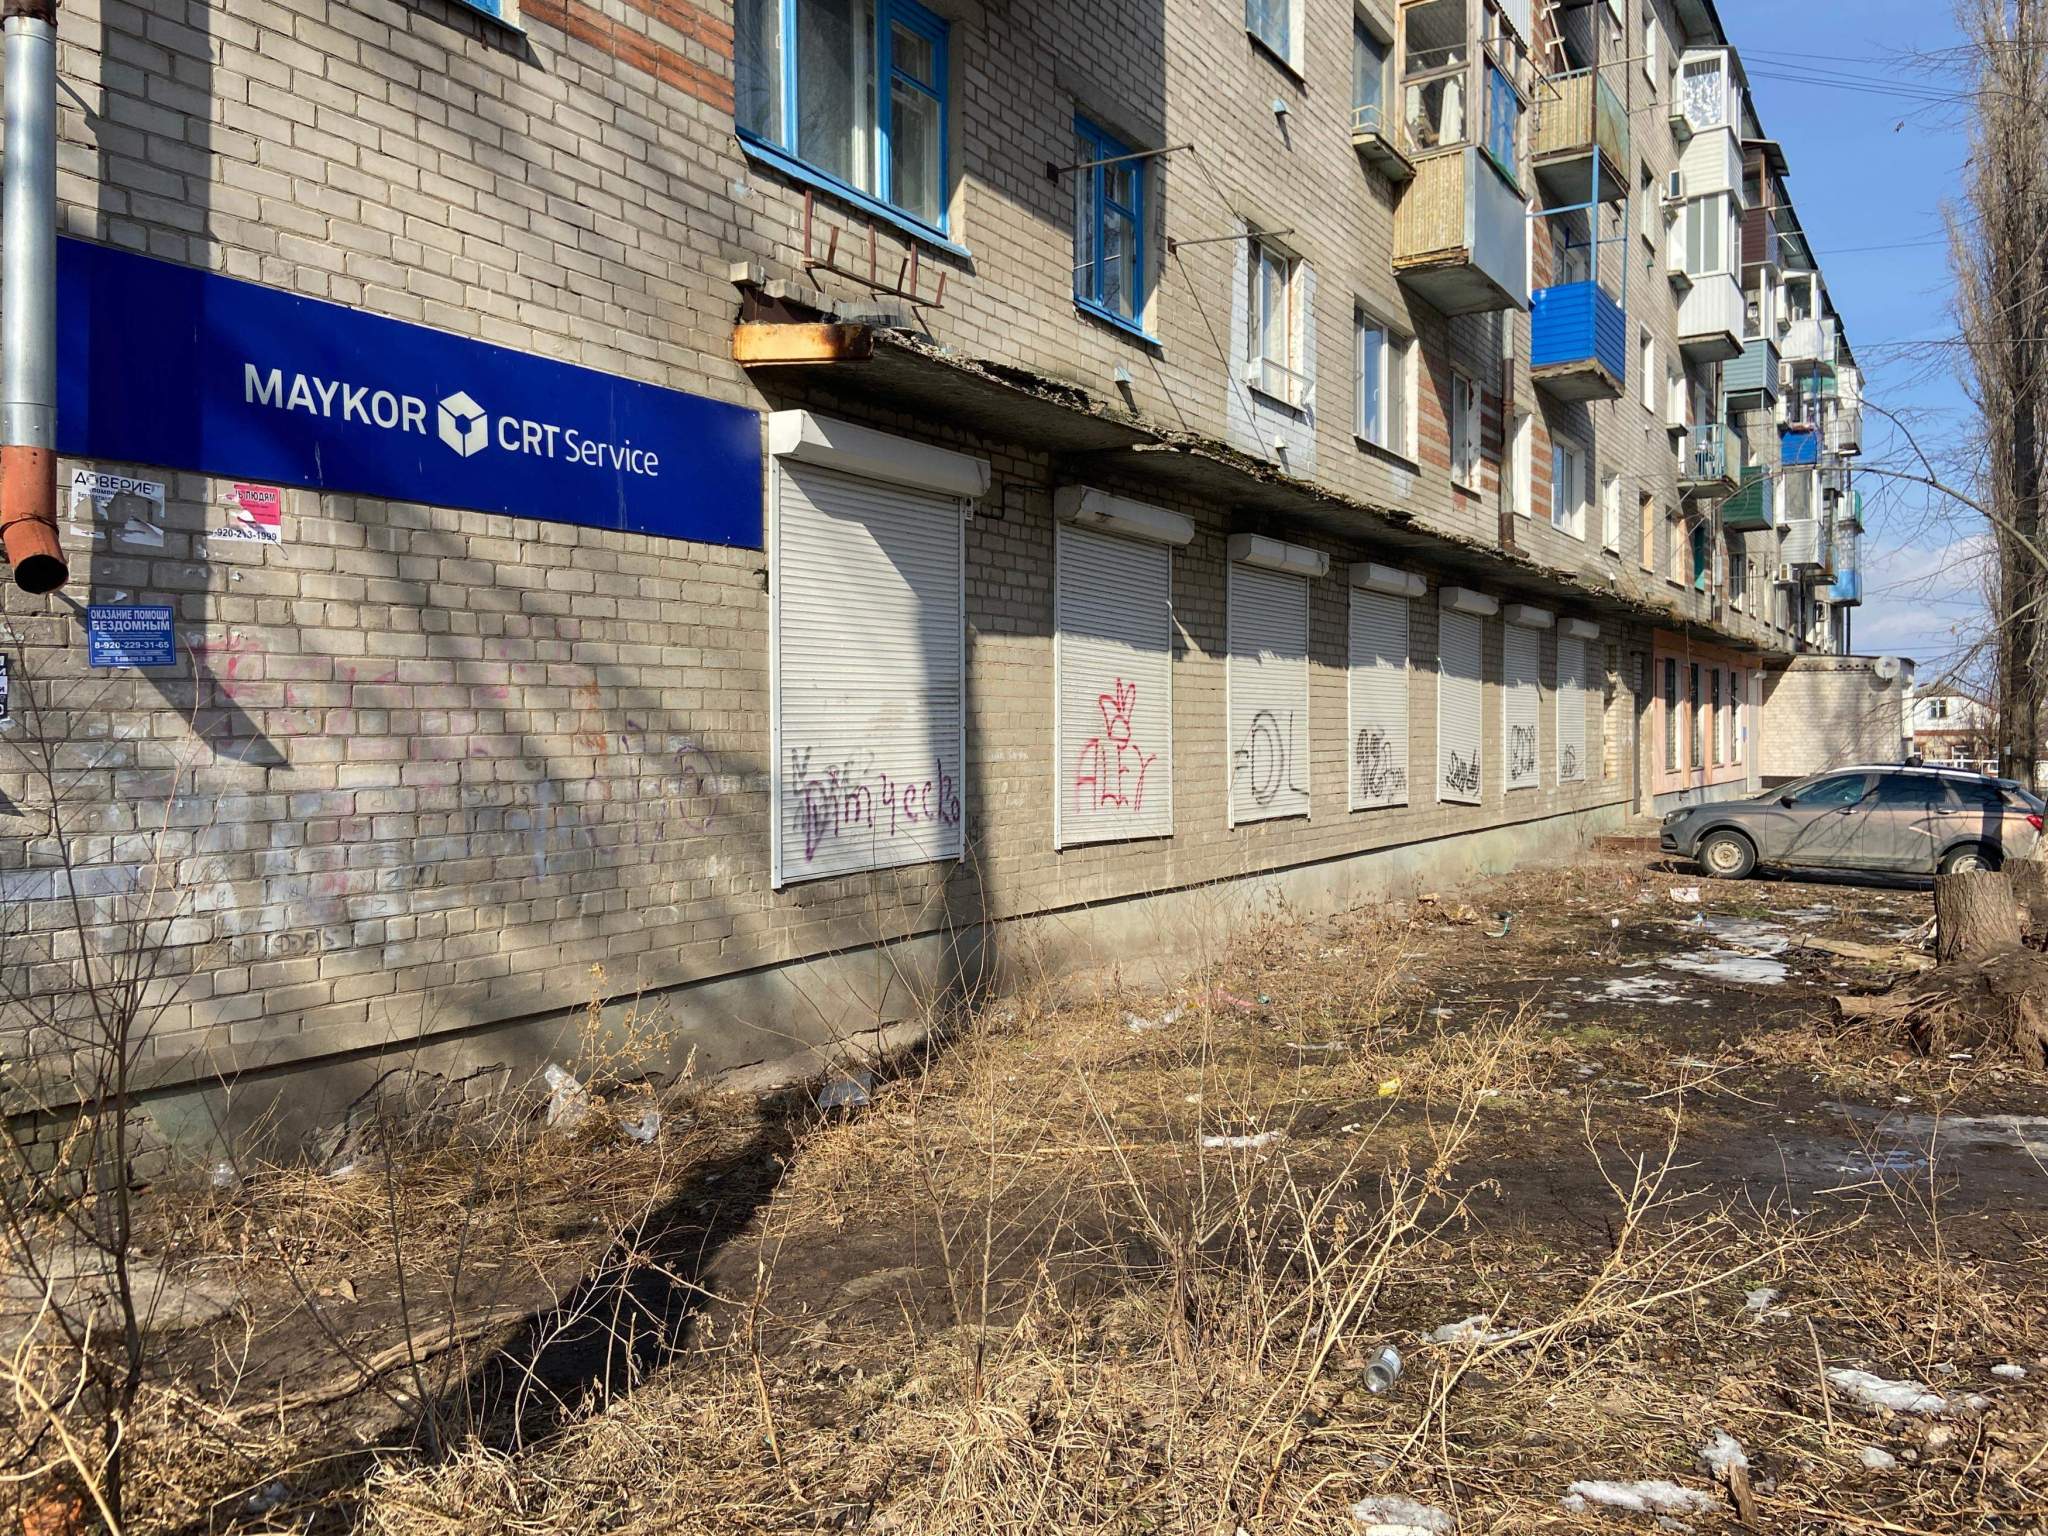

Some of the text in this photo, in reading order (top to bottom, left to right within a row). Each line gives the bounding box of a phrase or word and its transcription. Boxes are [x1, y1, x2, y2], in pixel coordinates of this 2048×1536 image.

[243, 363, 659, 477] MAYKOR CRT Service
[90, 609, 170, 621] ОКАЗАНИЕ ПОМОЩИ
[91, 620, 170, 632] БЕЗДОМНЫМ
